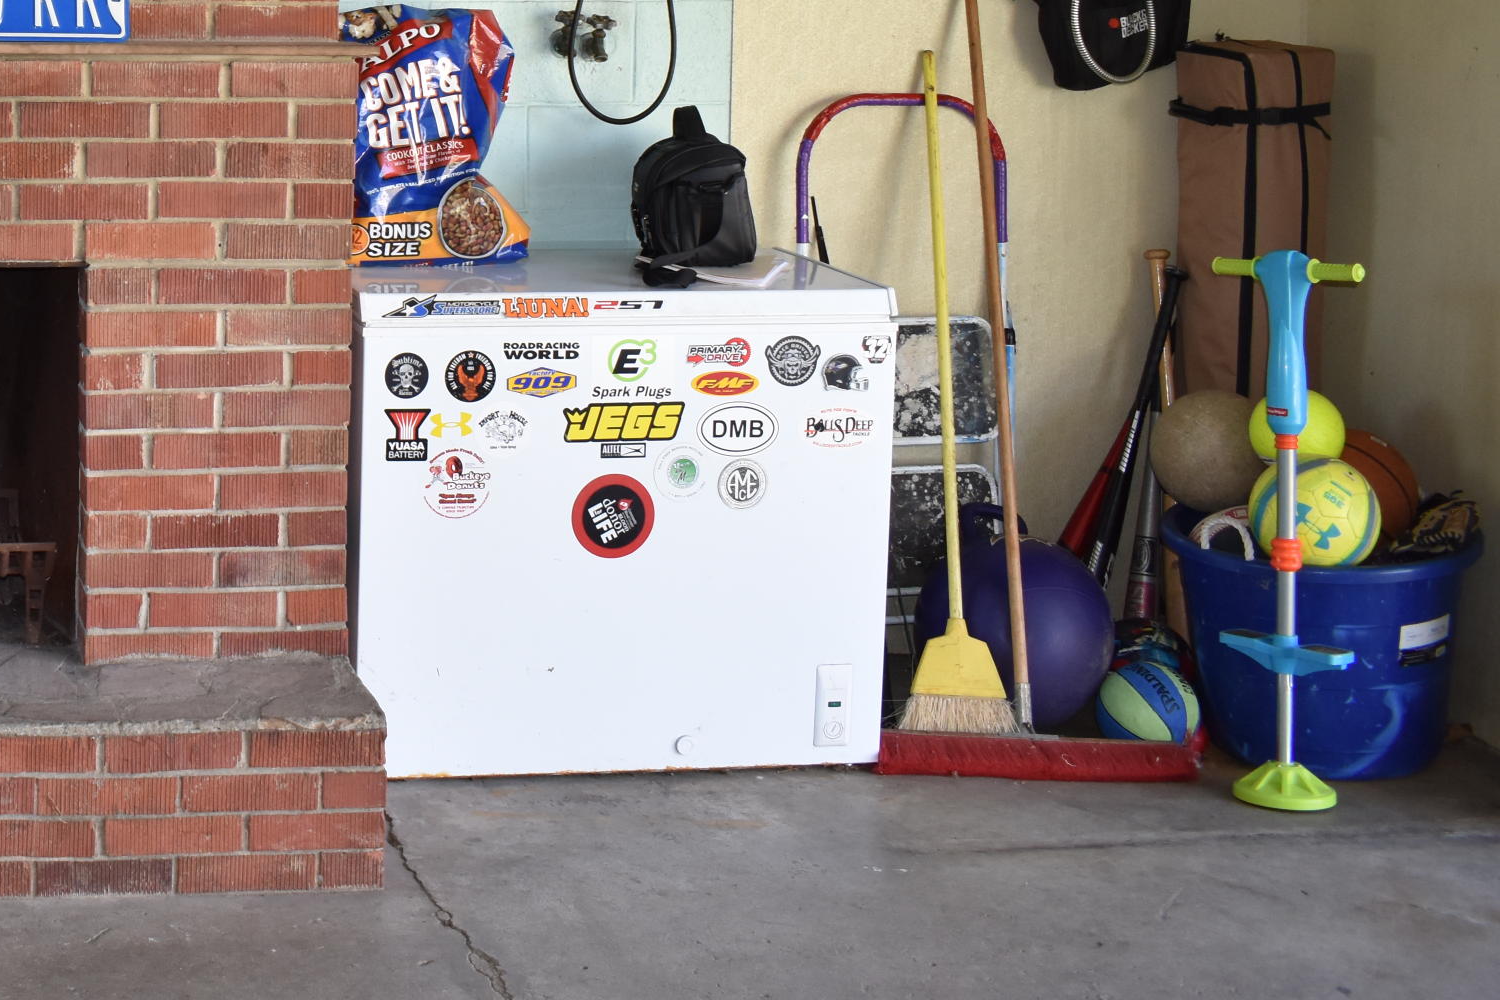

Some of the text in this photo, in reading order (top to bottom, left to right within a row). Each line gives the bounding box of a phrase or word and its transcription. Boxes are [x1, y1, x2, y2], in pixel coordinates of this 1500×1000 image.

[359, 55, 461, 112] COME &
[366, 94, 471, 149] GET IT!
[425, 140, 465, 153] CLASSICS
[368, 222, 432, 240] BONUS
[367, 241, 420, 257] SIZE
[431, 301, 499, 315] SUPERSTORE
[503, 350, 580, 360] WORLD
[689, 346, 740, 354] PRIMARY
[707, 353, 740, 361] DRIVE
[511, 375, 572, 390] 909
[697, 376, 754, 389] FMF
[591, 385, 672, 400] Spark Plugs
[478, 410, 529, 428] IMPORT HOUSE
[564, 401, 685, 442] JEGS
[845, 416, 874, 434] DEEP
[712, 419, 764, 439] DMB
[388, 441, 425, 450] YUASA
[602, 444, 621, 454] ALTEC
[388, 450, 425, 459] BATTERY
[452, 471, 491, 482] Buckeye
[447, 480, 486, 490] Donuts
[587, 502, 619, 544] LIFE
[602, 498, 627, 535] donor
